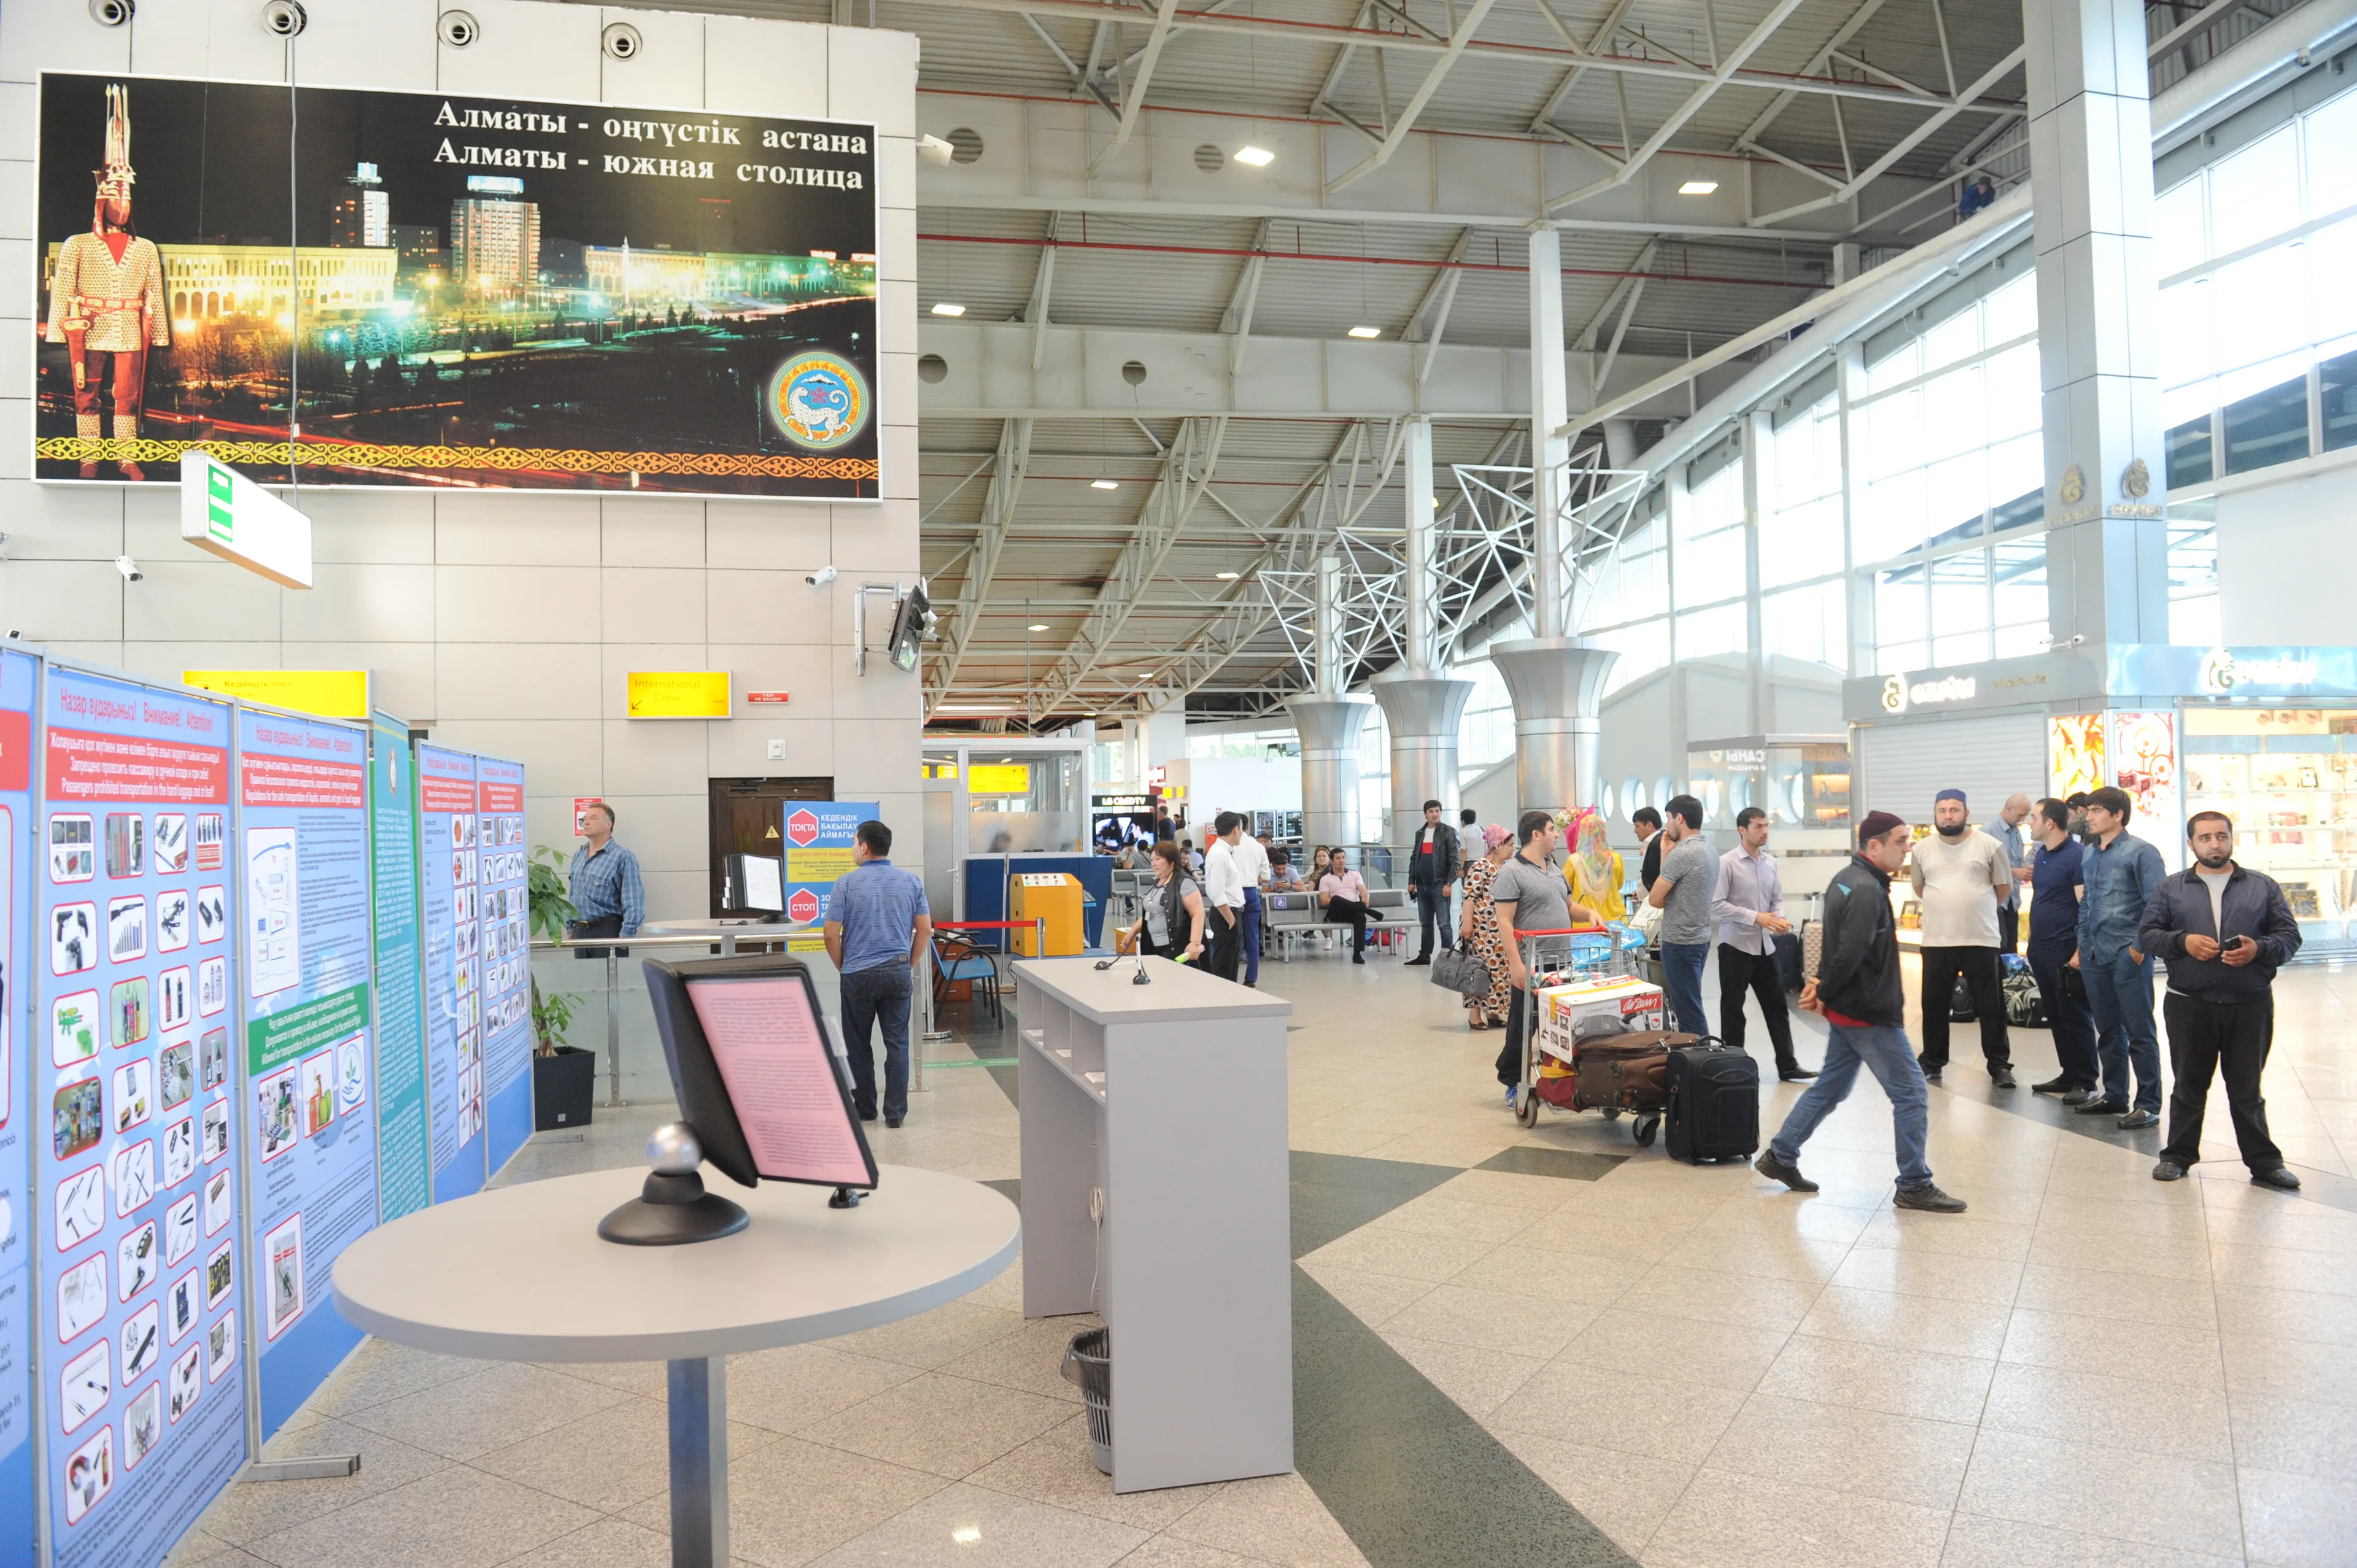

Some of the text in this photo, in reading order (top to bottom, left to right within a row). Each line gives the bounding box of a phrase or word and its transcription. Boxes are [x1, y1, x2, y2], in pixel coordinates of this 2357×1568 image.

[435, 101, 567, 134] Алматы
[603, 119, 741, 147] оңтүстік
[762, 129, 867, 155] астана
[434, 138, 567, 171] Алматы
[603, 153, 715, 179] южная
[737, 161, 864, 190] столица
[635, 679, 700, 689] International
[654, 693, 680, 702] Crew
[61, 687, 86, 719] Назар
[143, 701, 182, 728] Внимание!
[186, 709, 213, 733] Attention!
[71, 756, 100, 775] Запрещено
[62, 777, 93, 797] Passengers
[94, 780, 119, 797] prohibited
[791, 824, 816, 832] ТОҚТА
